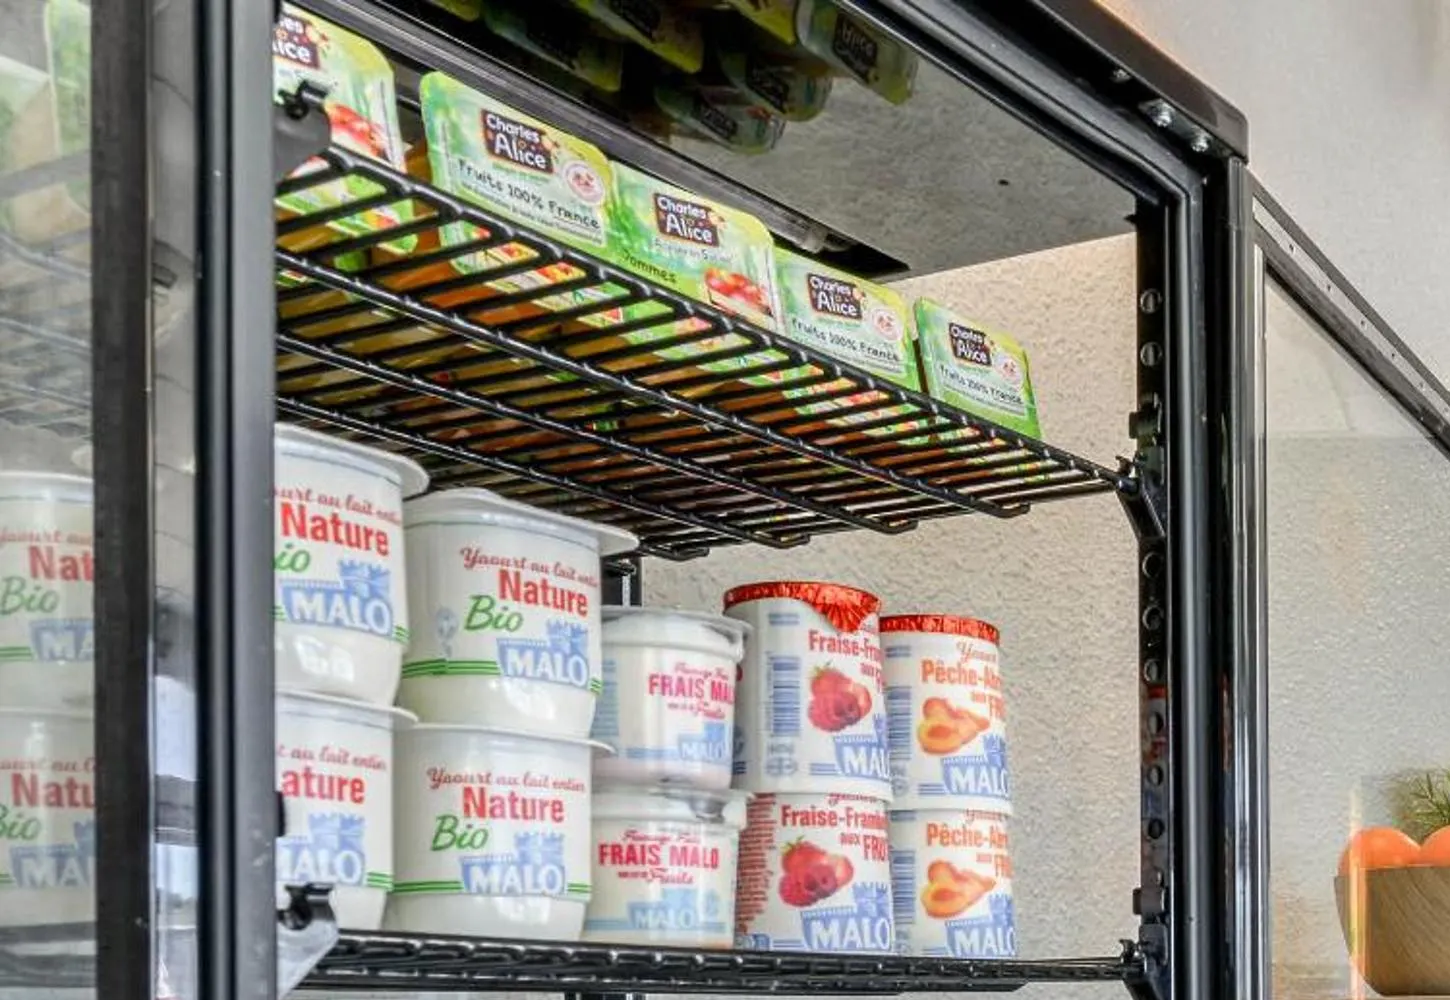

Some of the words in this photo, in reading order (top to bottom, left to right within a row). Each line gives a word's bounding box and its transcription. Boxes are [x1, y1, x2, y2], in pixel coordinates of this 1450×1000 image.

[272, 40, 312, 63] lice
[486, 113, 540, 144] Charles
[494, 132, 547, 170] Alice
[458, 158, 503, 192] Fruits
[508, 183, 544, 210] 100%
[548, 200, 601, 229] France
[656, 196, 707, 220] Charles
[665, 213, 713, 243] Alice
[809, 275, 852, 297] Charles
[816, 290, 858, 317] Alice
[956, 339, 988, 364] Alice
[281, 501, 389, 557] Nature
[28, 545, 94, 582] Nat
[273, 543, 311, 573] io
[460, 547, 527, 571] Yaourt
[0, 576, 60, 616] Bio
[498, 569, 589, 618] Nature
[290, 588, 392, 636] MALO
[464, 595, 524, 633] Bio
[506, 648, 589, 688] MALO
[648, 671, 705, 700] FRAIS
[11, 772, 95, 808] Natu
[281, 766, 366, 804] ature
[427, 766, 492, 790] Yaourt
[462, 786, 565, 824] Nature
[430, 813, 490, 852] Bio
[597, 843, 662, 867] FRAIS
[668, 847, 720, 871] MALO
[469, 863, 566, 898] MALO
[811, 916, 890, 950] MALO
